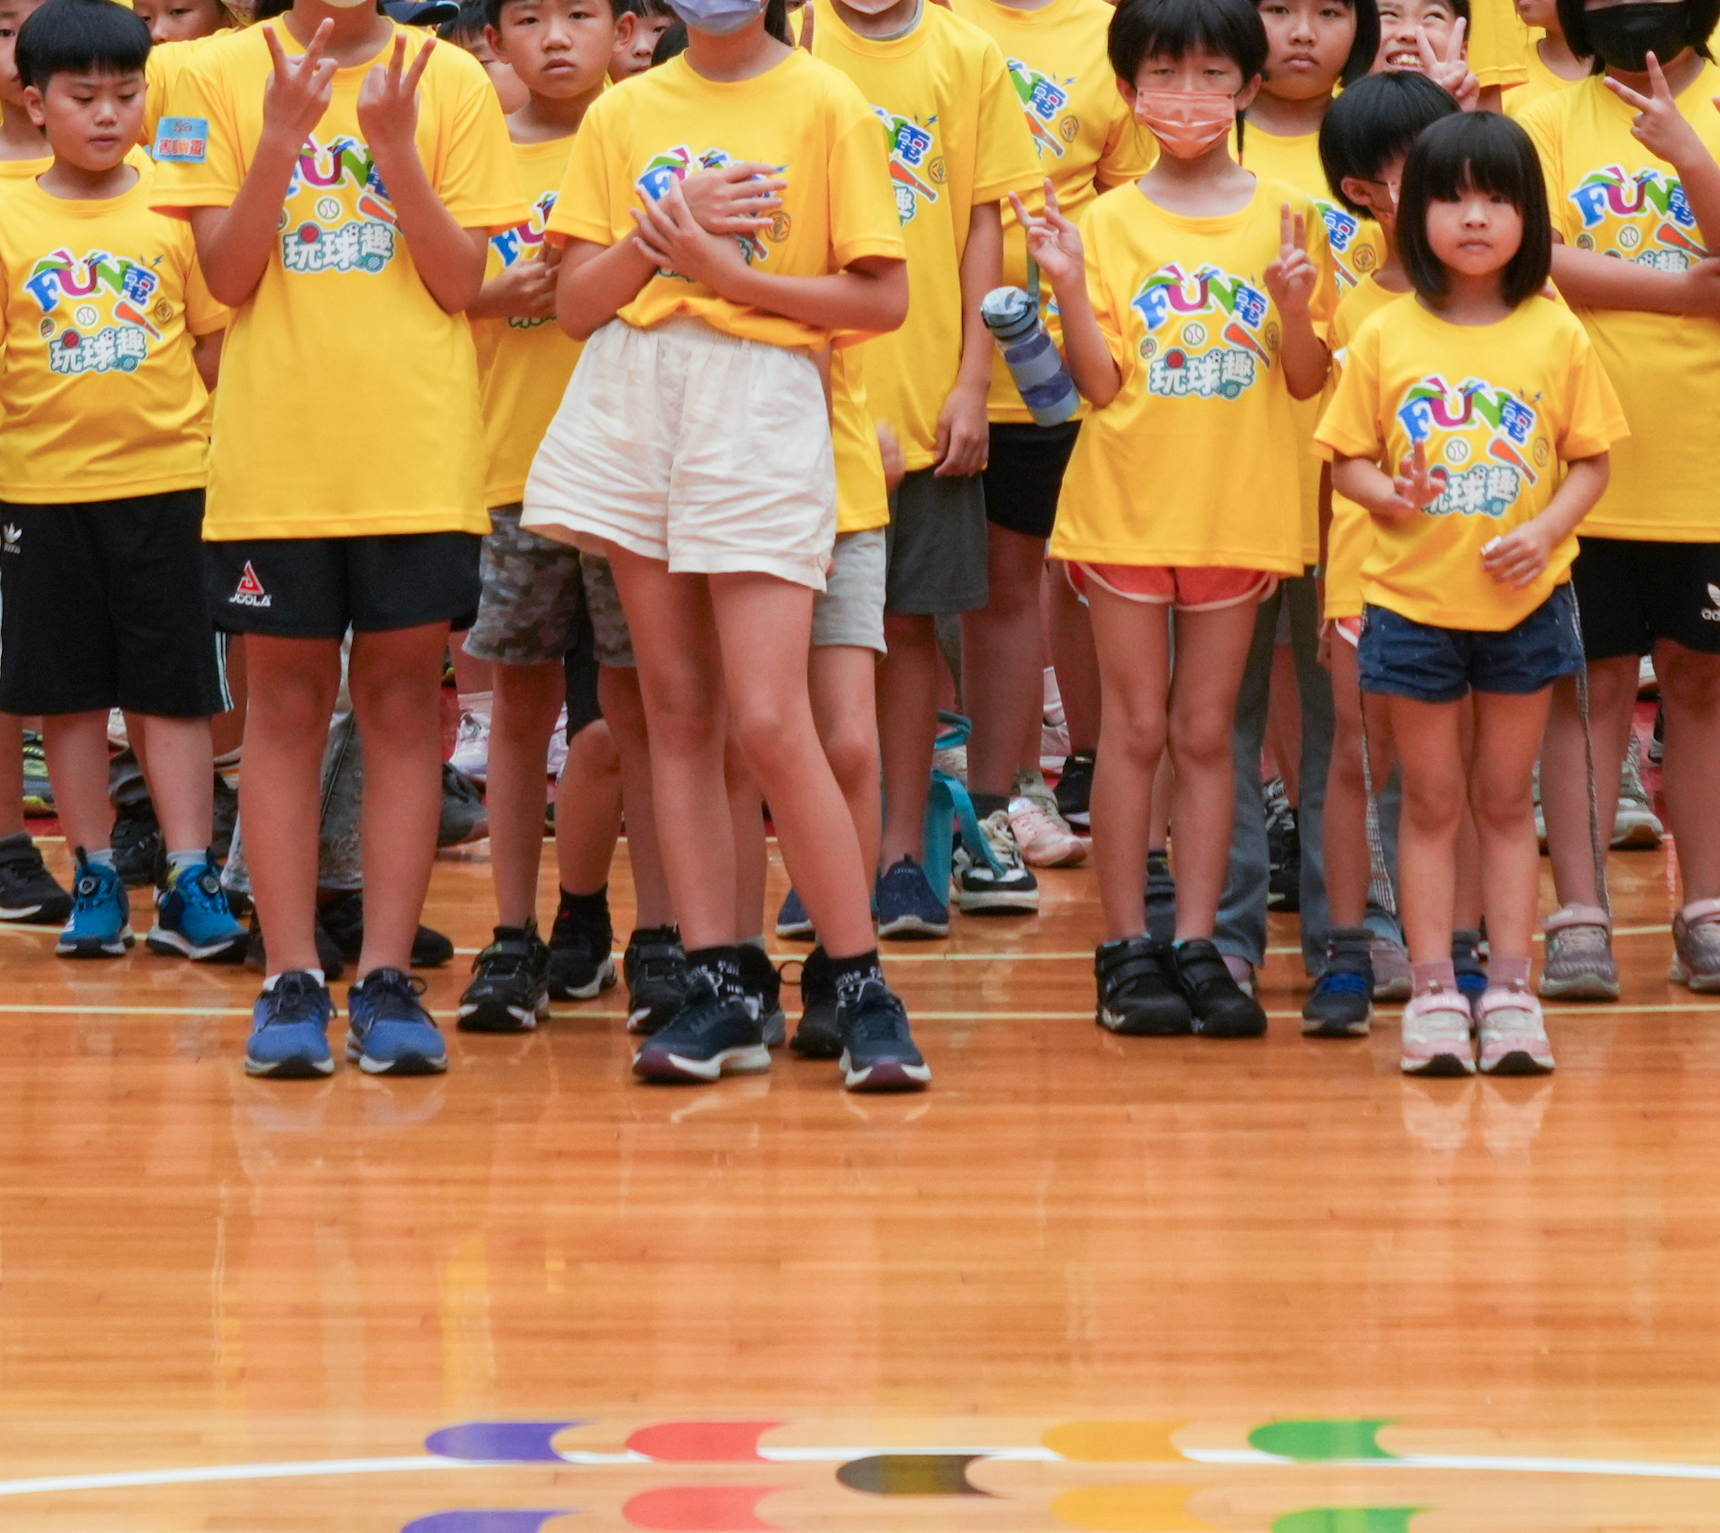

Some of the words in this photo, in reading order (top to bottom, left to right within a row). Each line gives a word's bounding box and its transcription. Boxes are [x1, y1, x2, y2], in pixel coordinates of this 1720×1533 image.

[283, 222, 394, 273] 玩球趣
[24, 248, 158, 313] FUN電
[1132, 263, 1270, 332] FUN電
[48, 326, 148, 374] 玩球趣
[1148, 348, 1255, 399] 玩球趣
[1397, 373, 1538, 445] FUN電
[228, 593, 272, 607] JOOLA
